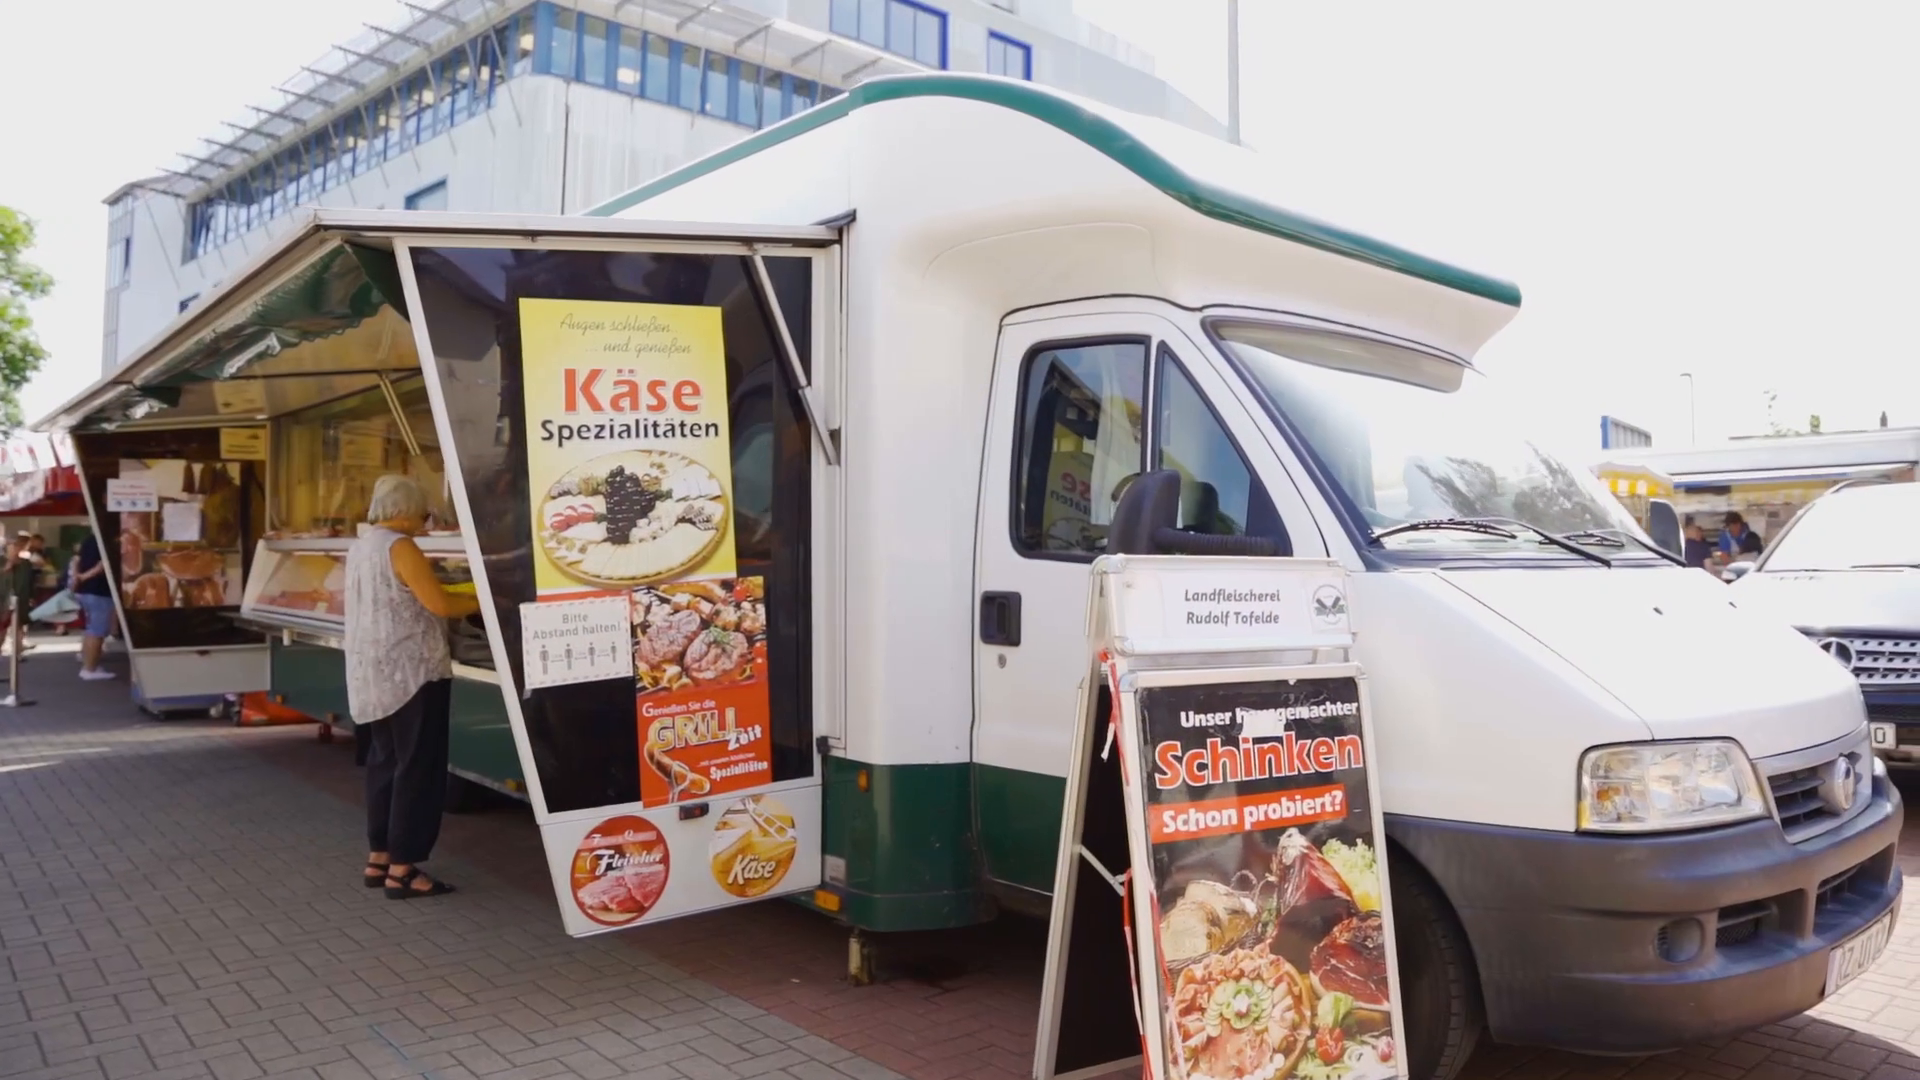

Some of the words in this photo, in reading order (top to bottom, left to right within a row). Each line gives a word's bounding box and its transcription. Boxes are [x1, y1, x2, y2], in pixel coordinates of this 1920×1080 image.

[560, 313, 606, 336] Augen
[634, 337, 692, 358] genießen
[564, 368, 702, 413] Käse
[541, 418, 719, 447] Spezialitäten
[1184, 588, 1281, 604] Landfleischerei
[533, 626, 579, 640] Abstand
[583, 621, 621, 635] halten!
[562, 613, 589, 624] Bitte
[1187, 611, 1231, 626] Rudolf
[1233, 611, 1280, 626] Tofelde
[648, 707, 744, 752] GRILL
[1180, 710, 1232, 728] Unser
[727, 724, 762, 751] Zeit
[1154, 731, 1364, 789] Schinken
[1162, 807, 1238, 833] Schon
[1243, 790, 1344, 830] probiert?
[727, 854, 777, 885] Käse
